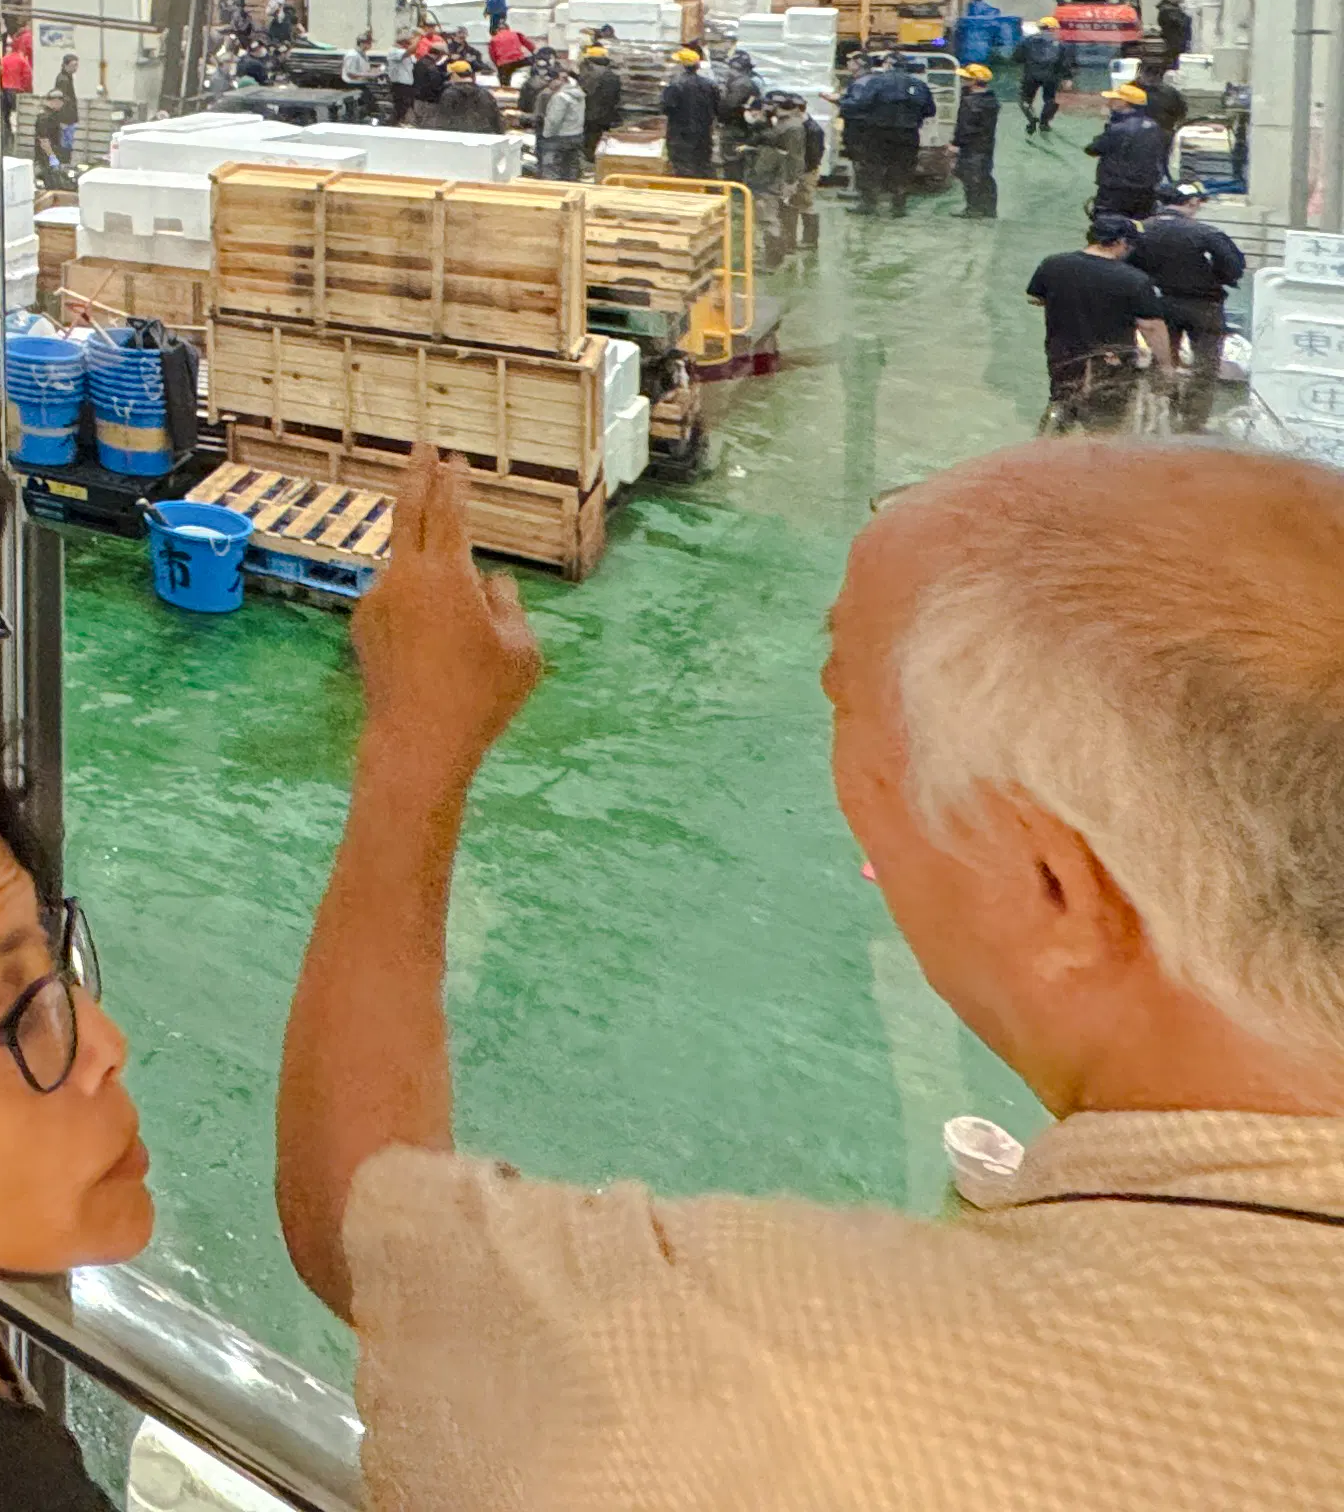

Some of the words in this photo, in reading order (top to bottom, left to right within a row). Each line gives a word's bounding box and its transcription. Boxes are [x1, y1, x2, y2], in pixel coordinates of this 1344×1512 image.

[1068, 22, 1119, 30] TOYOTA
[1292, 330, 1344, 357] 東
[159, 538, 192, 594] 市
